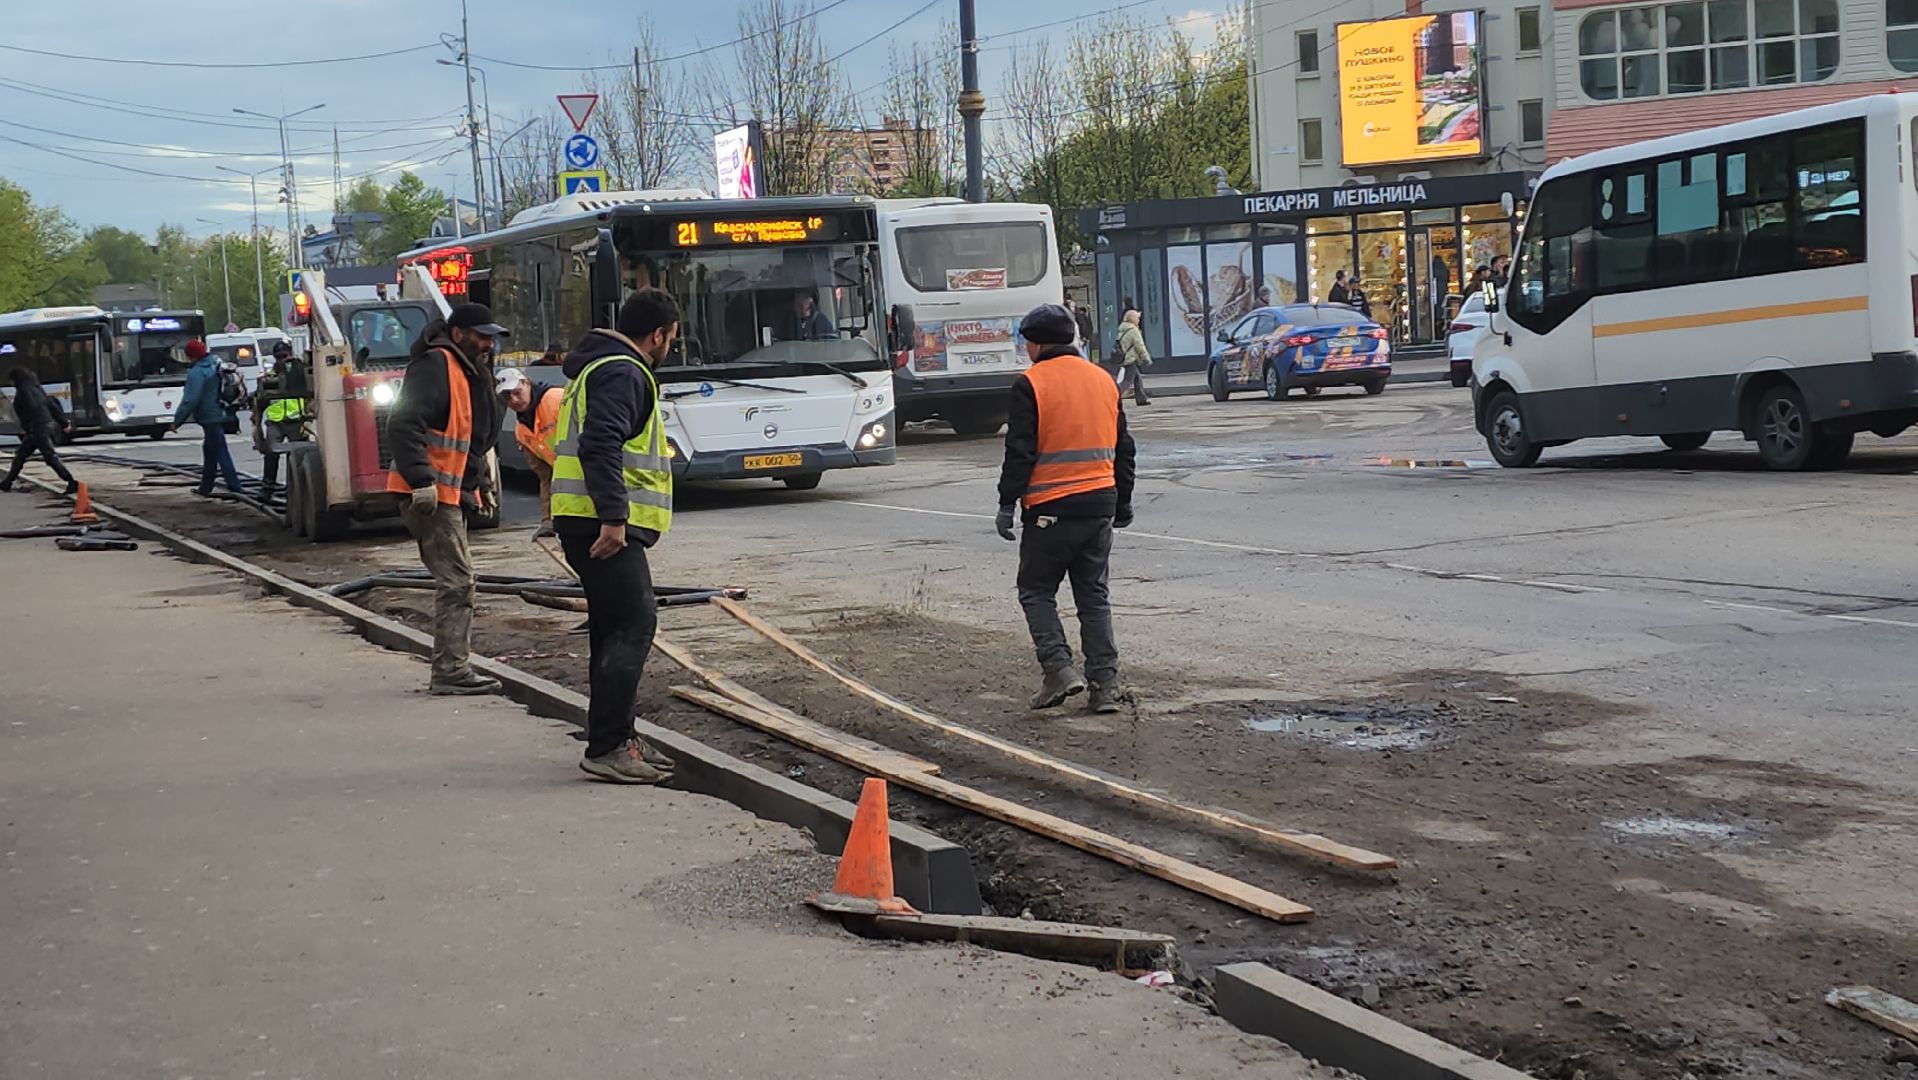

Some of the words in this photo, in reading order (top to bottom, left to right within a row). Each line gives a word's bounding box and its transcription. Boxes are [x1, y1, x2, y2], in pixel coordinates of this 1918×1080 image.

[1345, 55, 1405, 67] ПУШКИНО
[1244, 193, 1320, 214] ПЕКАРНЯ
[1333, 184, 1428, 208] МЕЛЬНИЦА
[677, 222, 699, 246] 21
